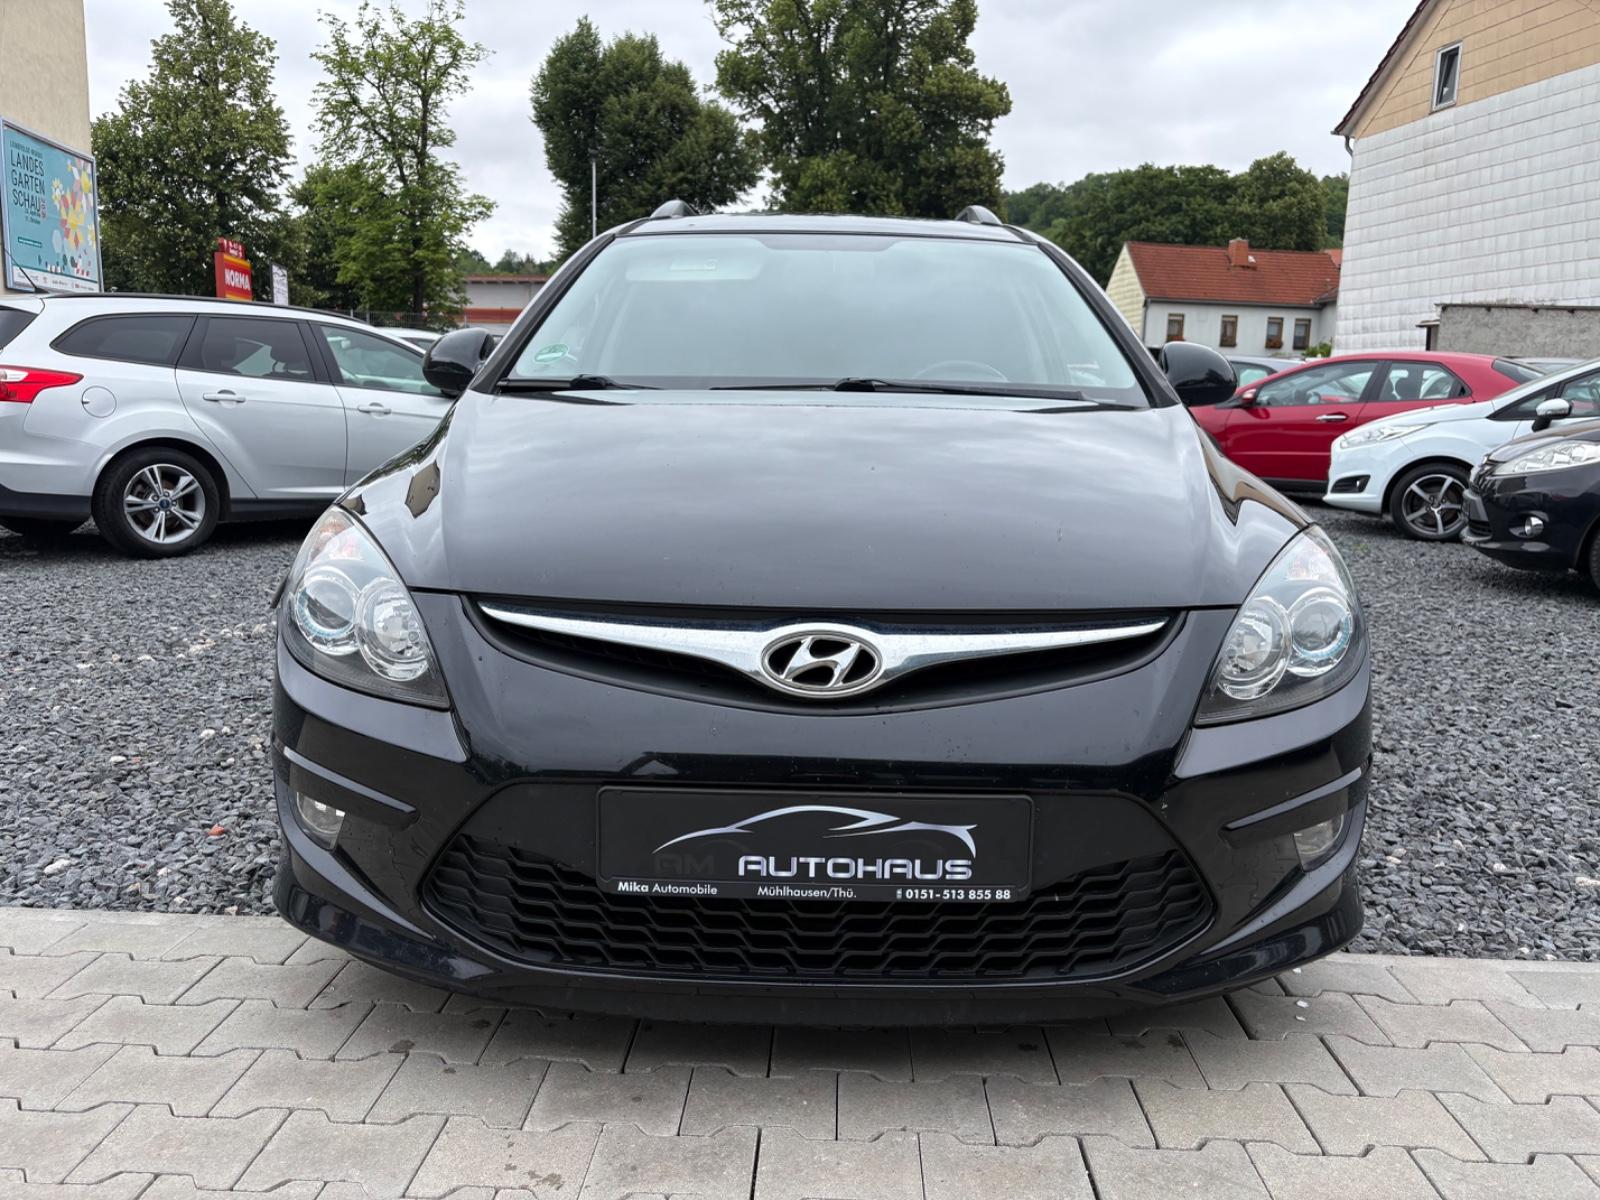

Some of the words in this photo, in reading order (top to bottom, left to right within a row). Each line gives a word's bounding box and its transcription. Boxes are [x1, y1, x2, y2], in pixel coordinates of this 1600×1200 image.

[10, 149, 45, 177] LANDES
[11, 169, 46, 196] GARTEN
[12, 188, 41, 212] SCHAU
[224, 268, 251, 291] NORMA
[738, 855, 973, 881] AUTOHAUS
[617, 881, 649, 893] Mika
[651, 882, 718, 896] Automobile
[757, 885, 857, 900] Mühlhausen/Thü.
[968, 889, 992, 900] 855
[995, 889, 1012, 900] 88
